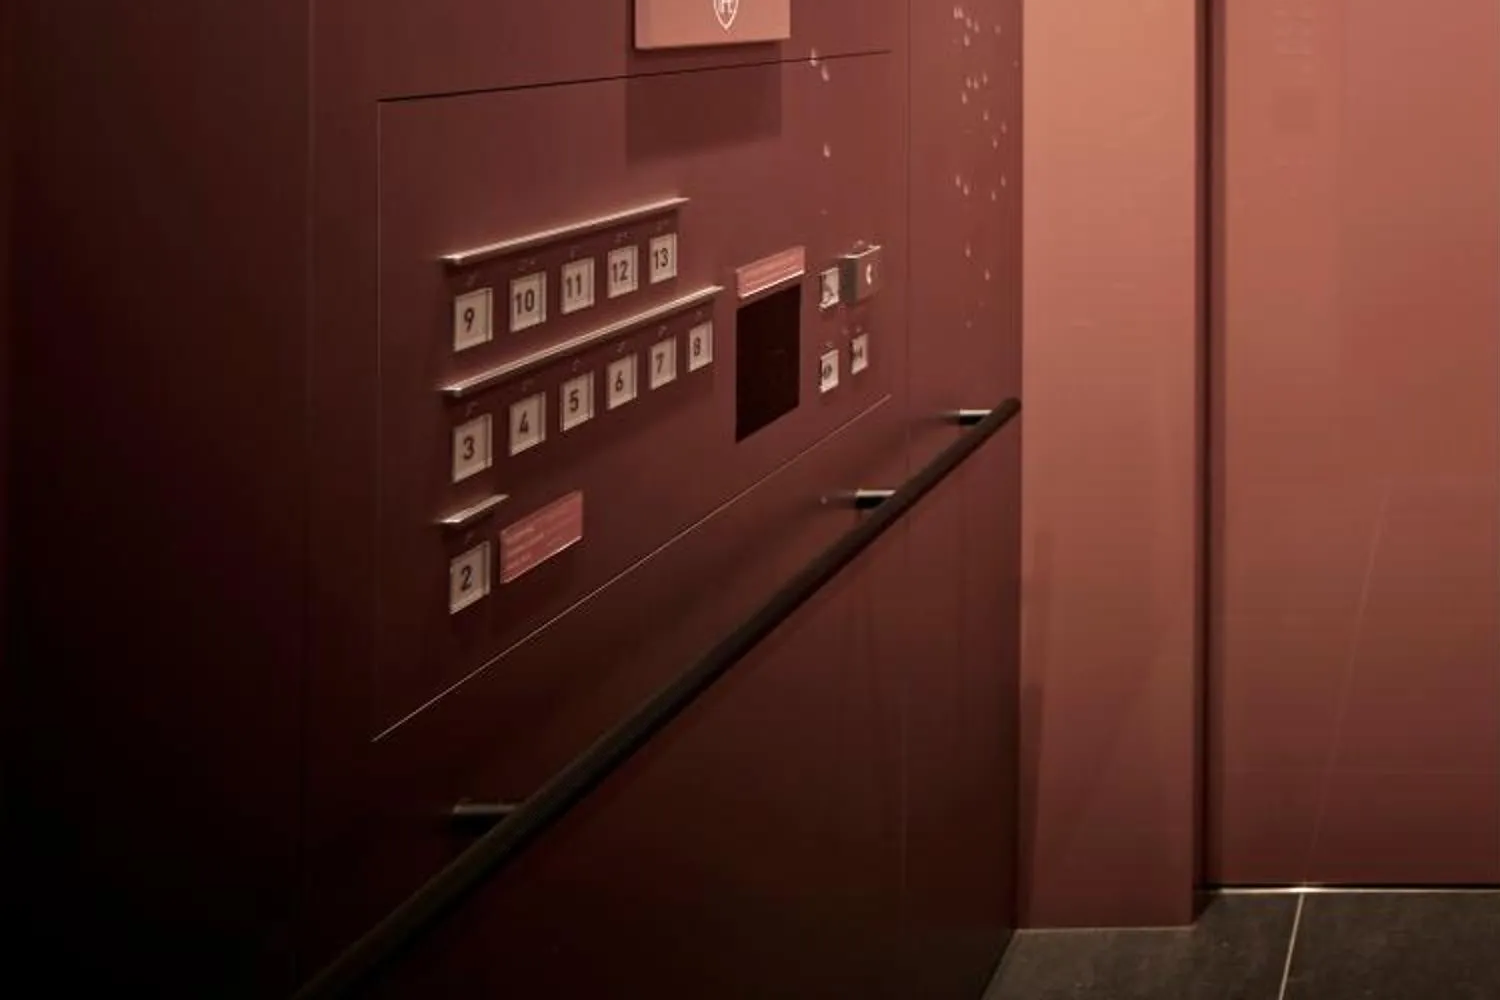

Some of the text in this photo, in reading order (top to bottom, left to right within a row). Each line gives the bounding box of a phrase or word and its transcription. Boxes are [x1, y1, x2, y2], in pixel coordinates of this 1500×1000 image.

[654, 247, 669, 270] 13
[612, 260, 629, 283] 12
[566, 273, 582, 298] 11
[515, 288, 535, 315] 10
[463, 307, 475, 333] 9
[693, 337, 702, 357] 8
[655, 352, 665, 374] 7
[615, 371, 623, 392] 6
[569, 389, 579, 412] 5
[518, 411, 529, 434] 4
[462, 436, 475, 460] 3
[461, 565, 472, 592] 2
